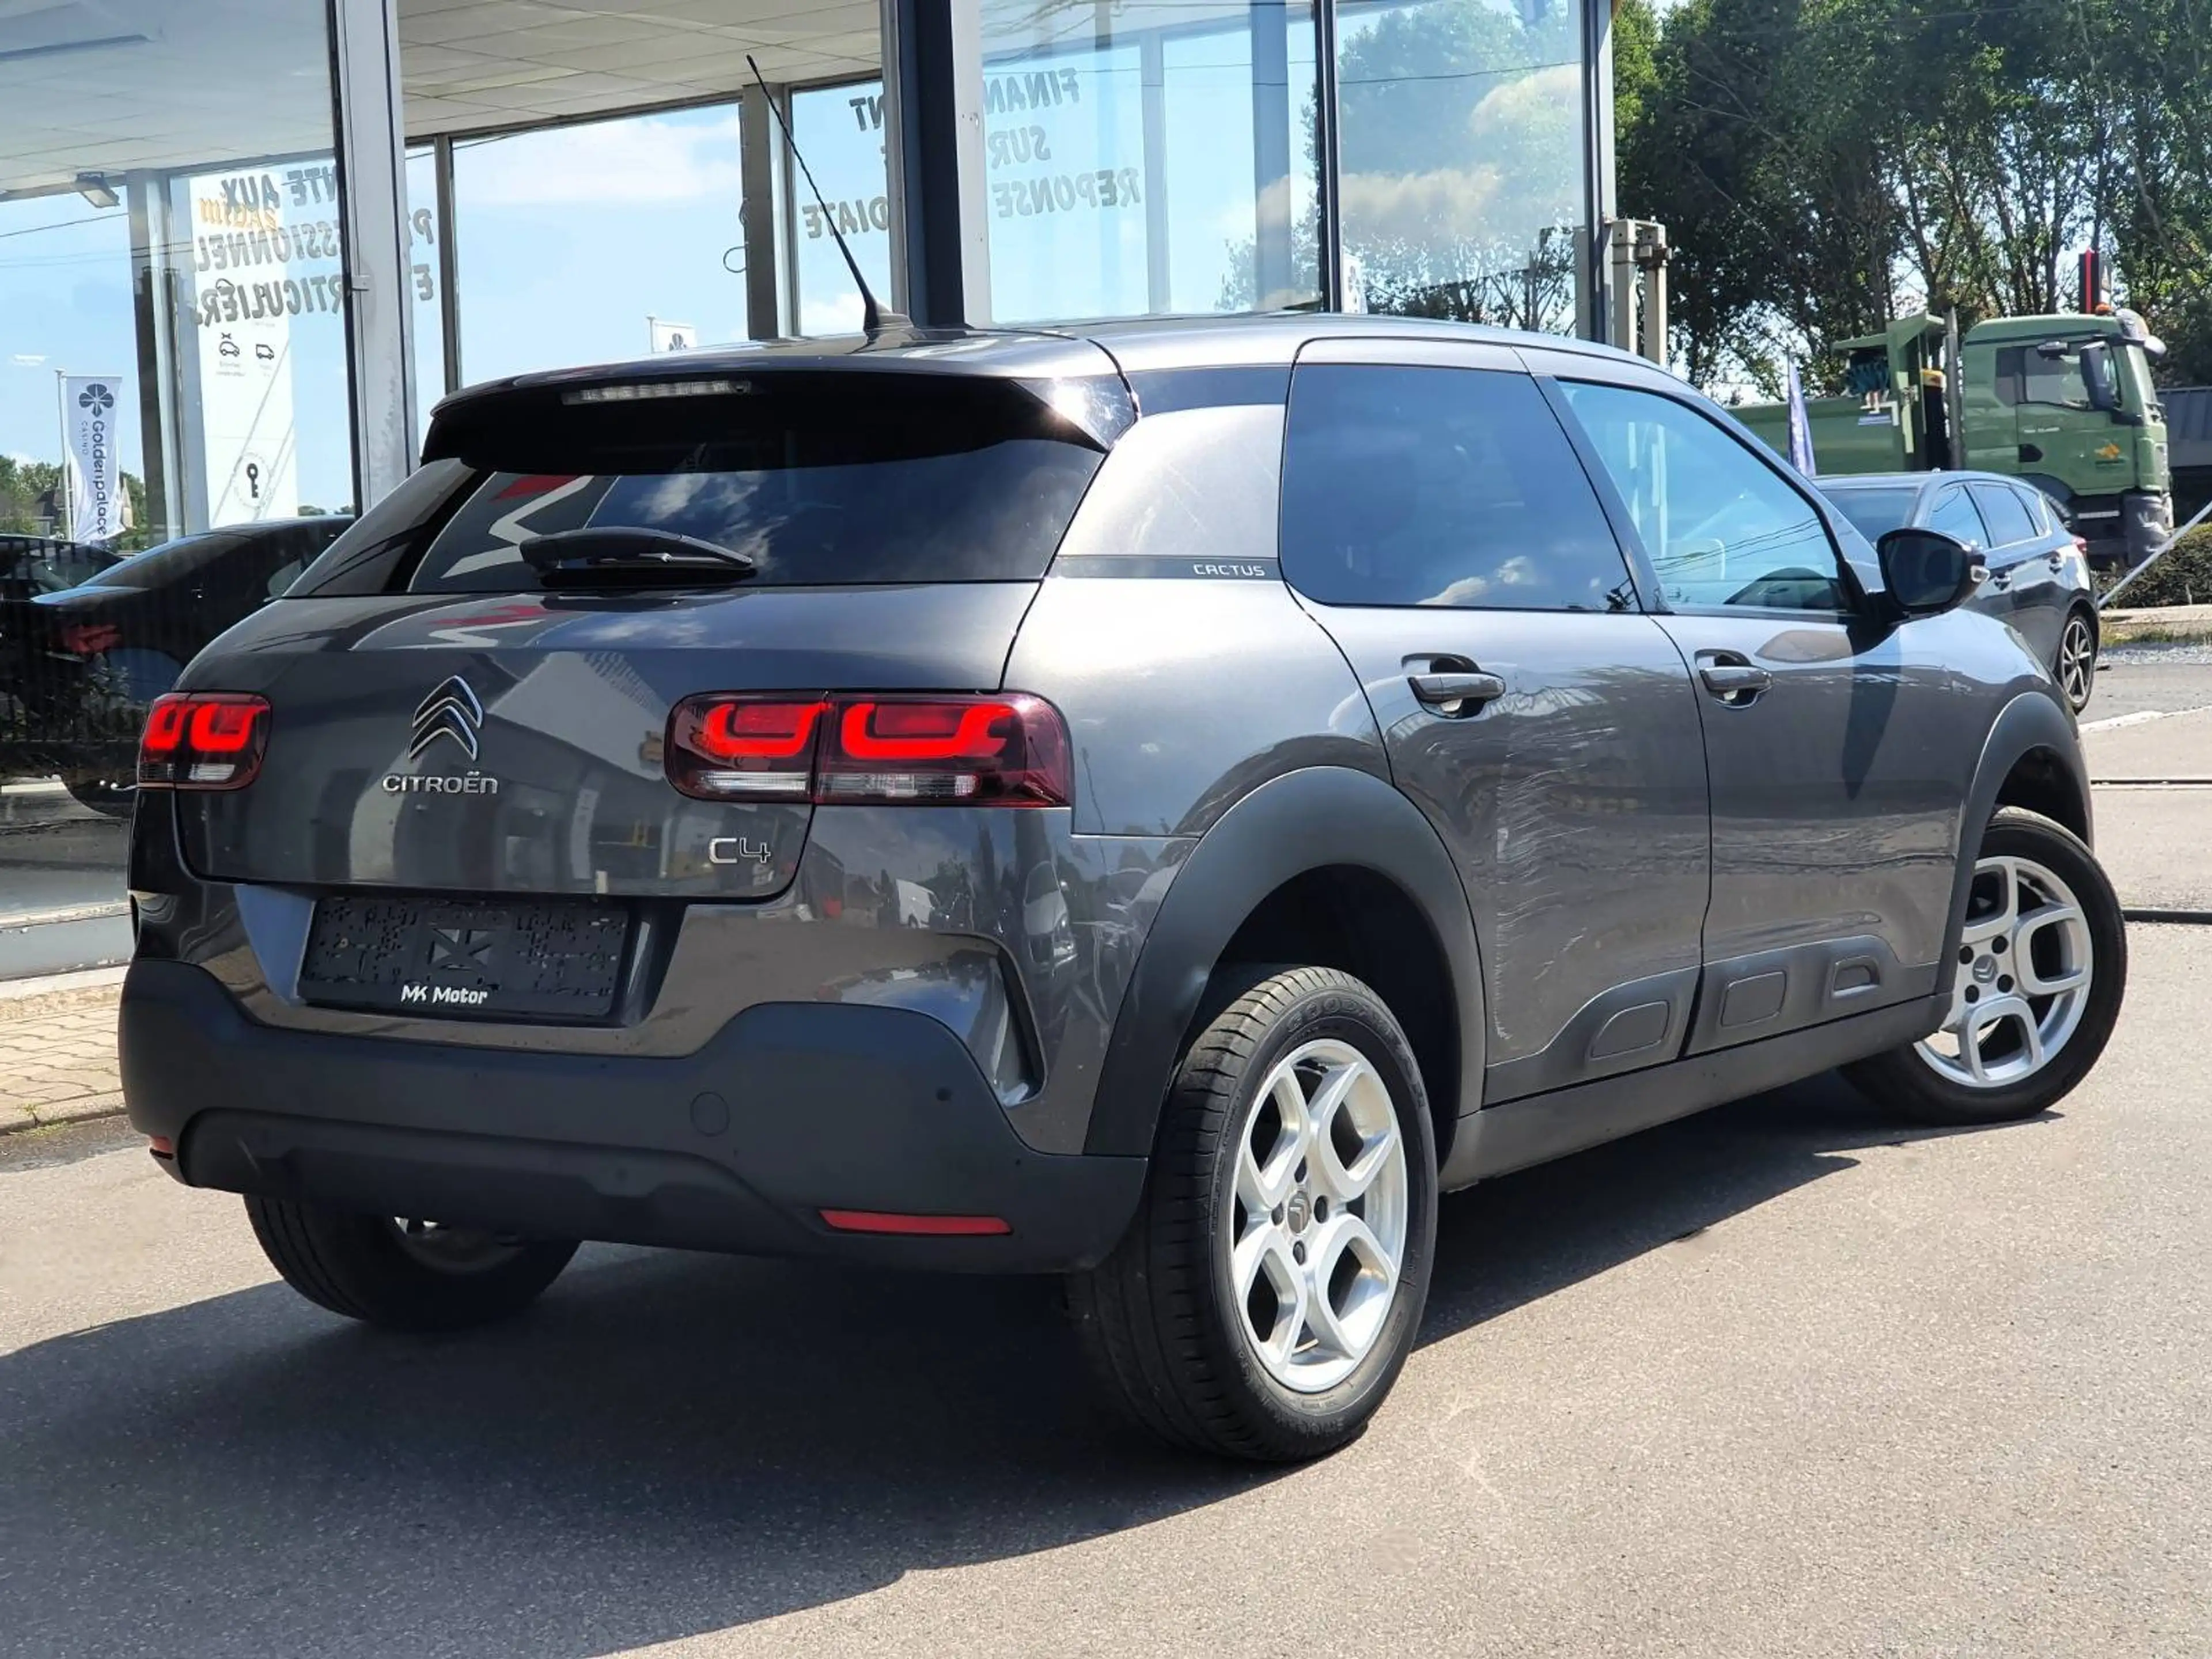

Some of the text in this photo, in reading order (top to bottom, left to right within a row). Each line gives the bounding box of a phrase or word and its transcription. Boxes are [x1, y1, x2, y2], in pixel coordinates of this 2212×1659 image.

[92, 420, 108, 535] Goldenpalace
[1192, 564, 1266, 577] CACTUS
[709, 837, 771, 863] C4
[401, 985, 488, 1005] MK Motor
